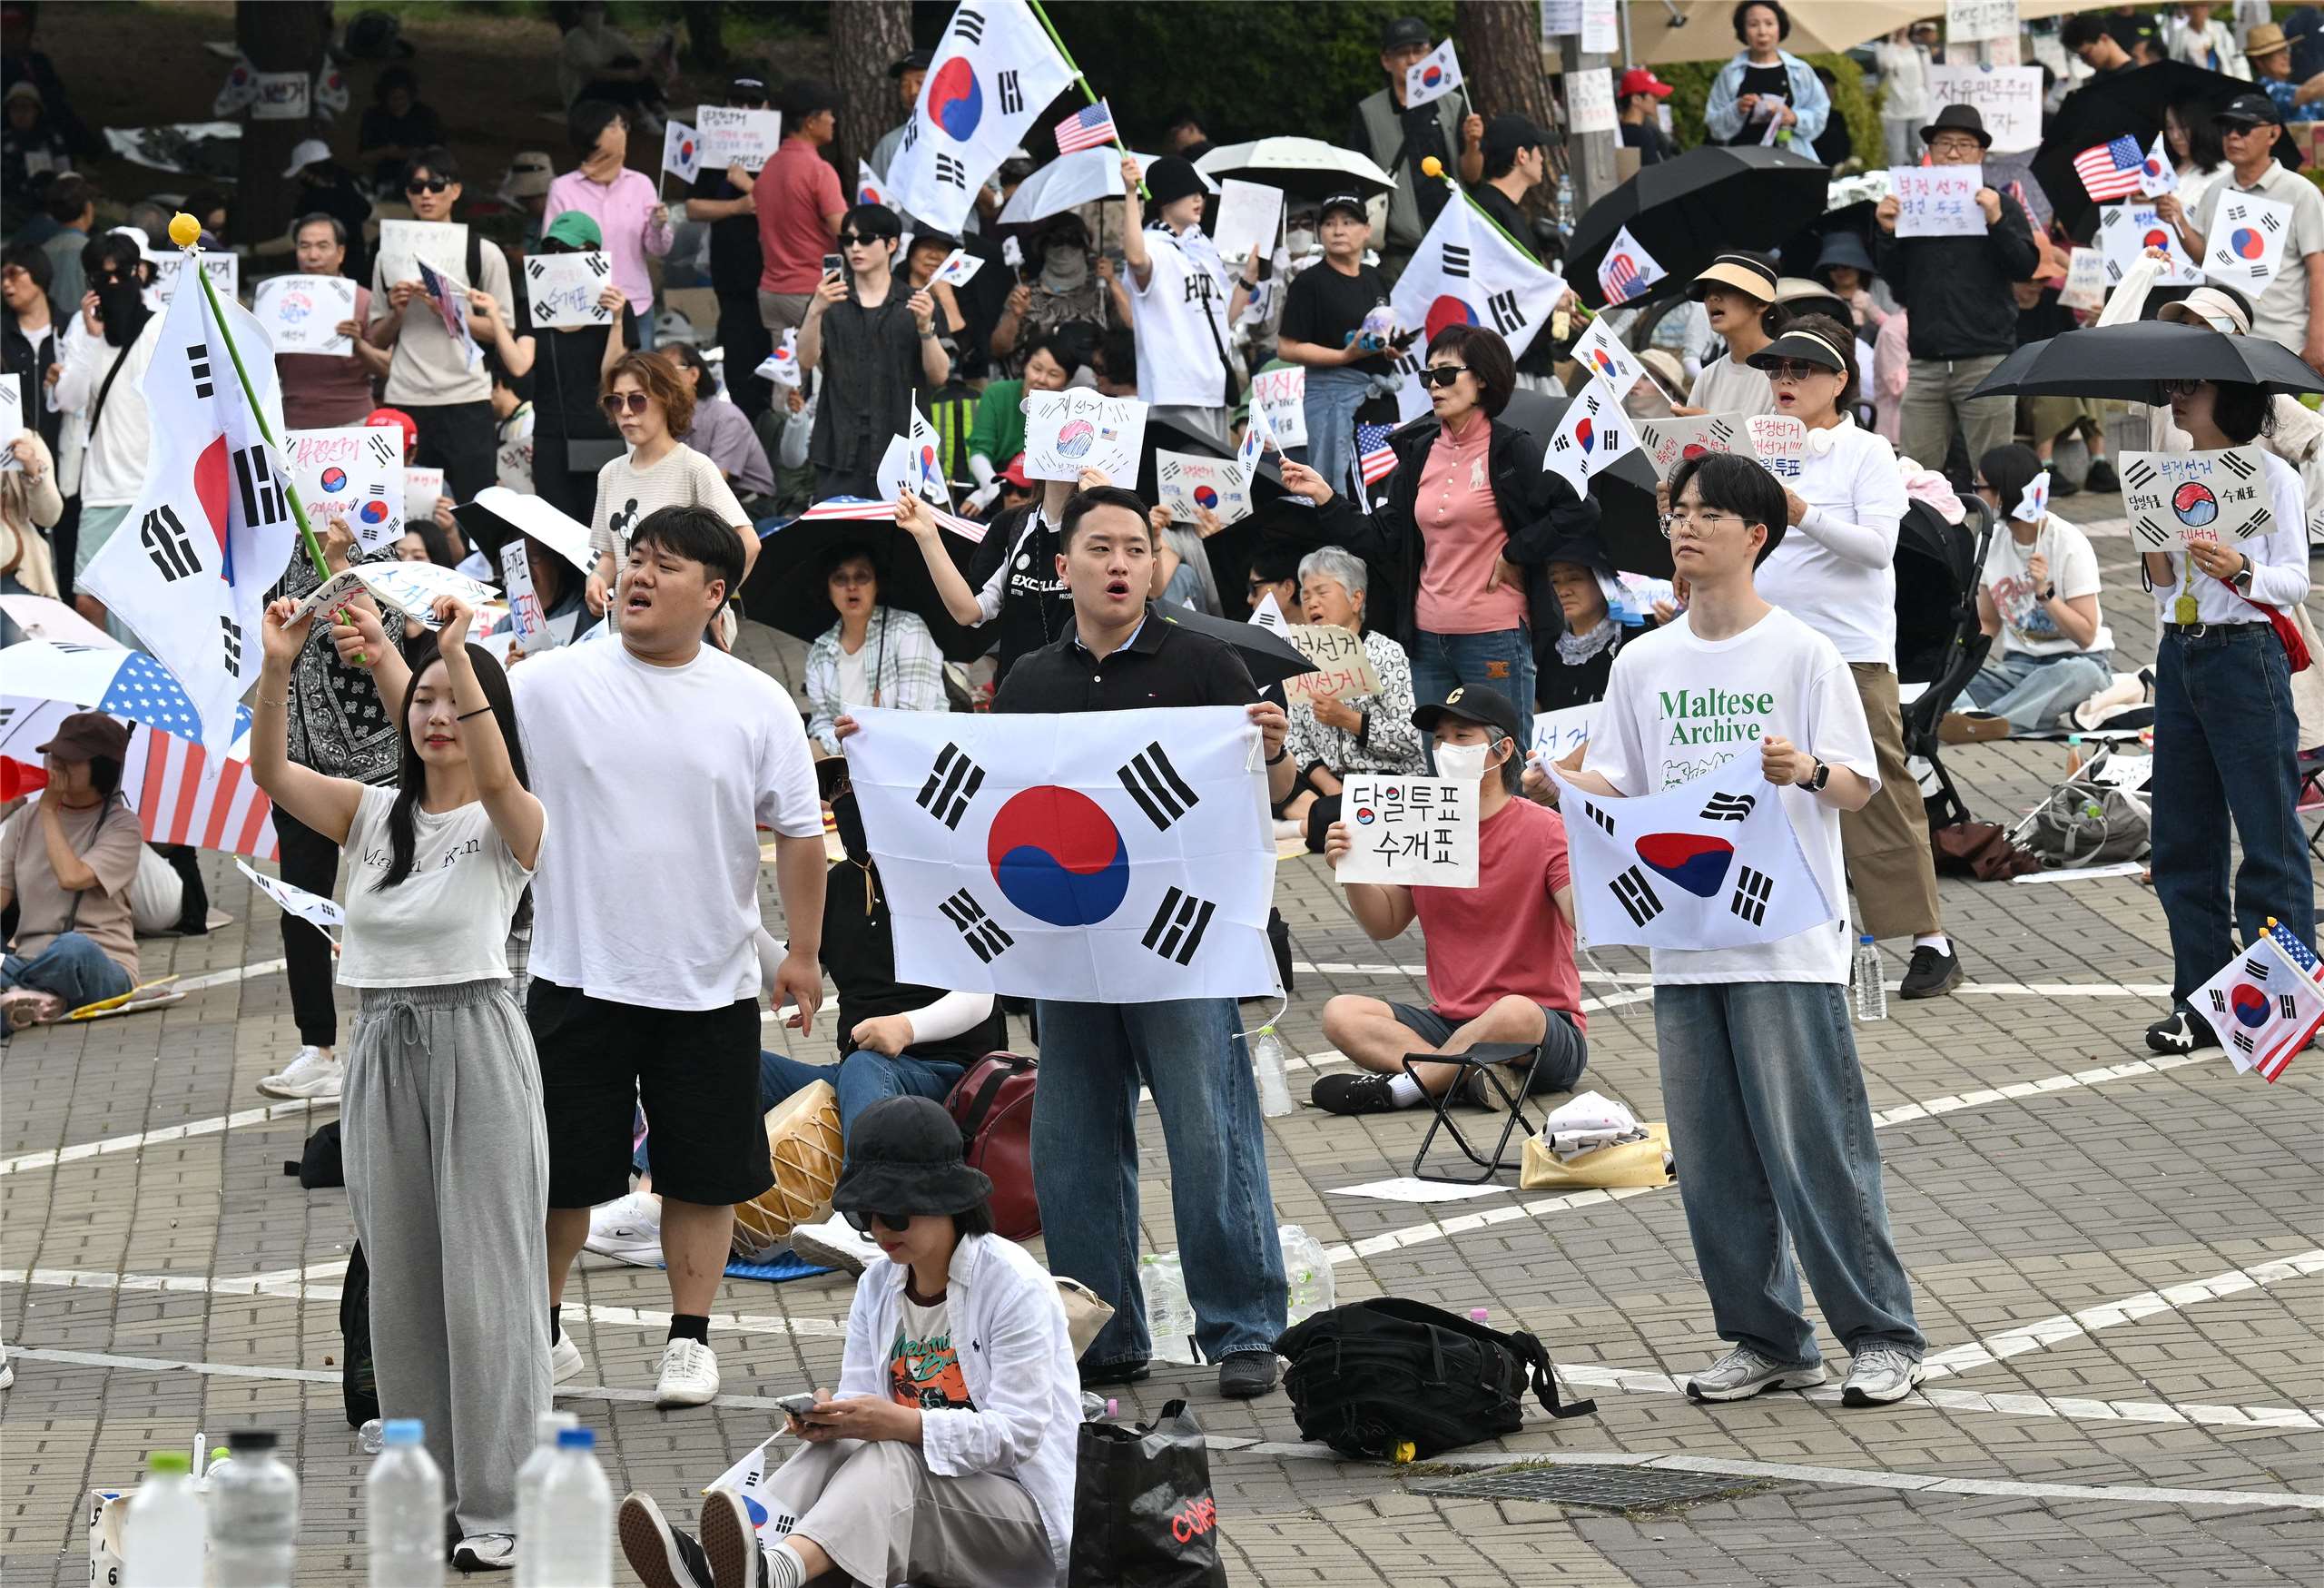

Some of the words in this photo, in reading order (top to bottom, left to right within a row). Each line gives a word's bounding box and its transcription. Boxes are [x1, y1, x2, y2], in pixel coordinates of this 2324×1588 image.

[1935, 78, 2034, 104] 자유민주주의
[1056, 393, 1103, 420] 재선거
[1751, 419, 1802, 439] 부정선거
[2162, 459, 2212, 482] 부정선거
[2128, 493, 2165, 512] 당일투표
[2222, 486, 2259, 505] 수개표
[1446, 687, 1464, 705] C
[1659, 688, 1774, 721] Maltese
[1669, 718, 1761, 745] Archive
[1354, 783, 1461, 825] 당일투표
[1372, 829, 1459, 867] 수개표
[1172, 1497, 1216, 1544] coles
[108, 1566, 117, 1586] 6
